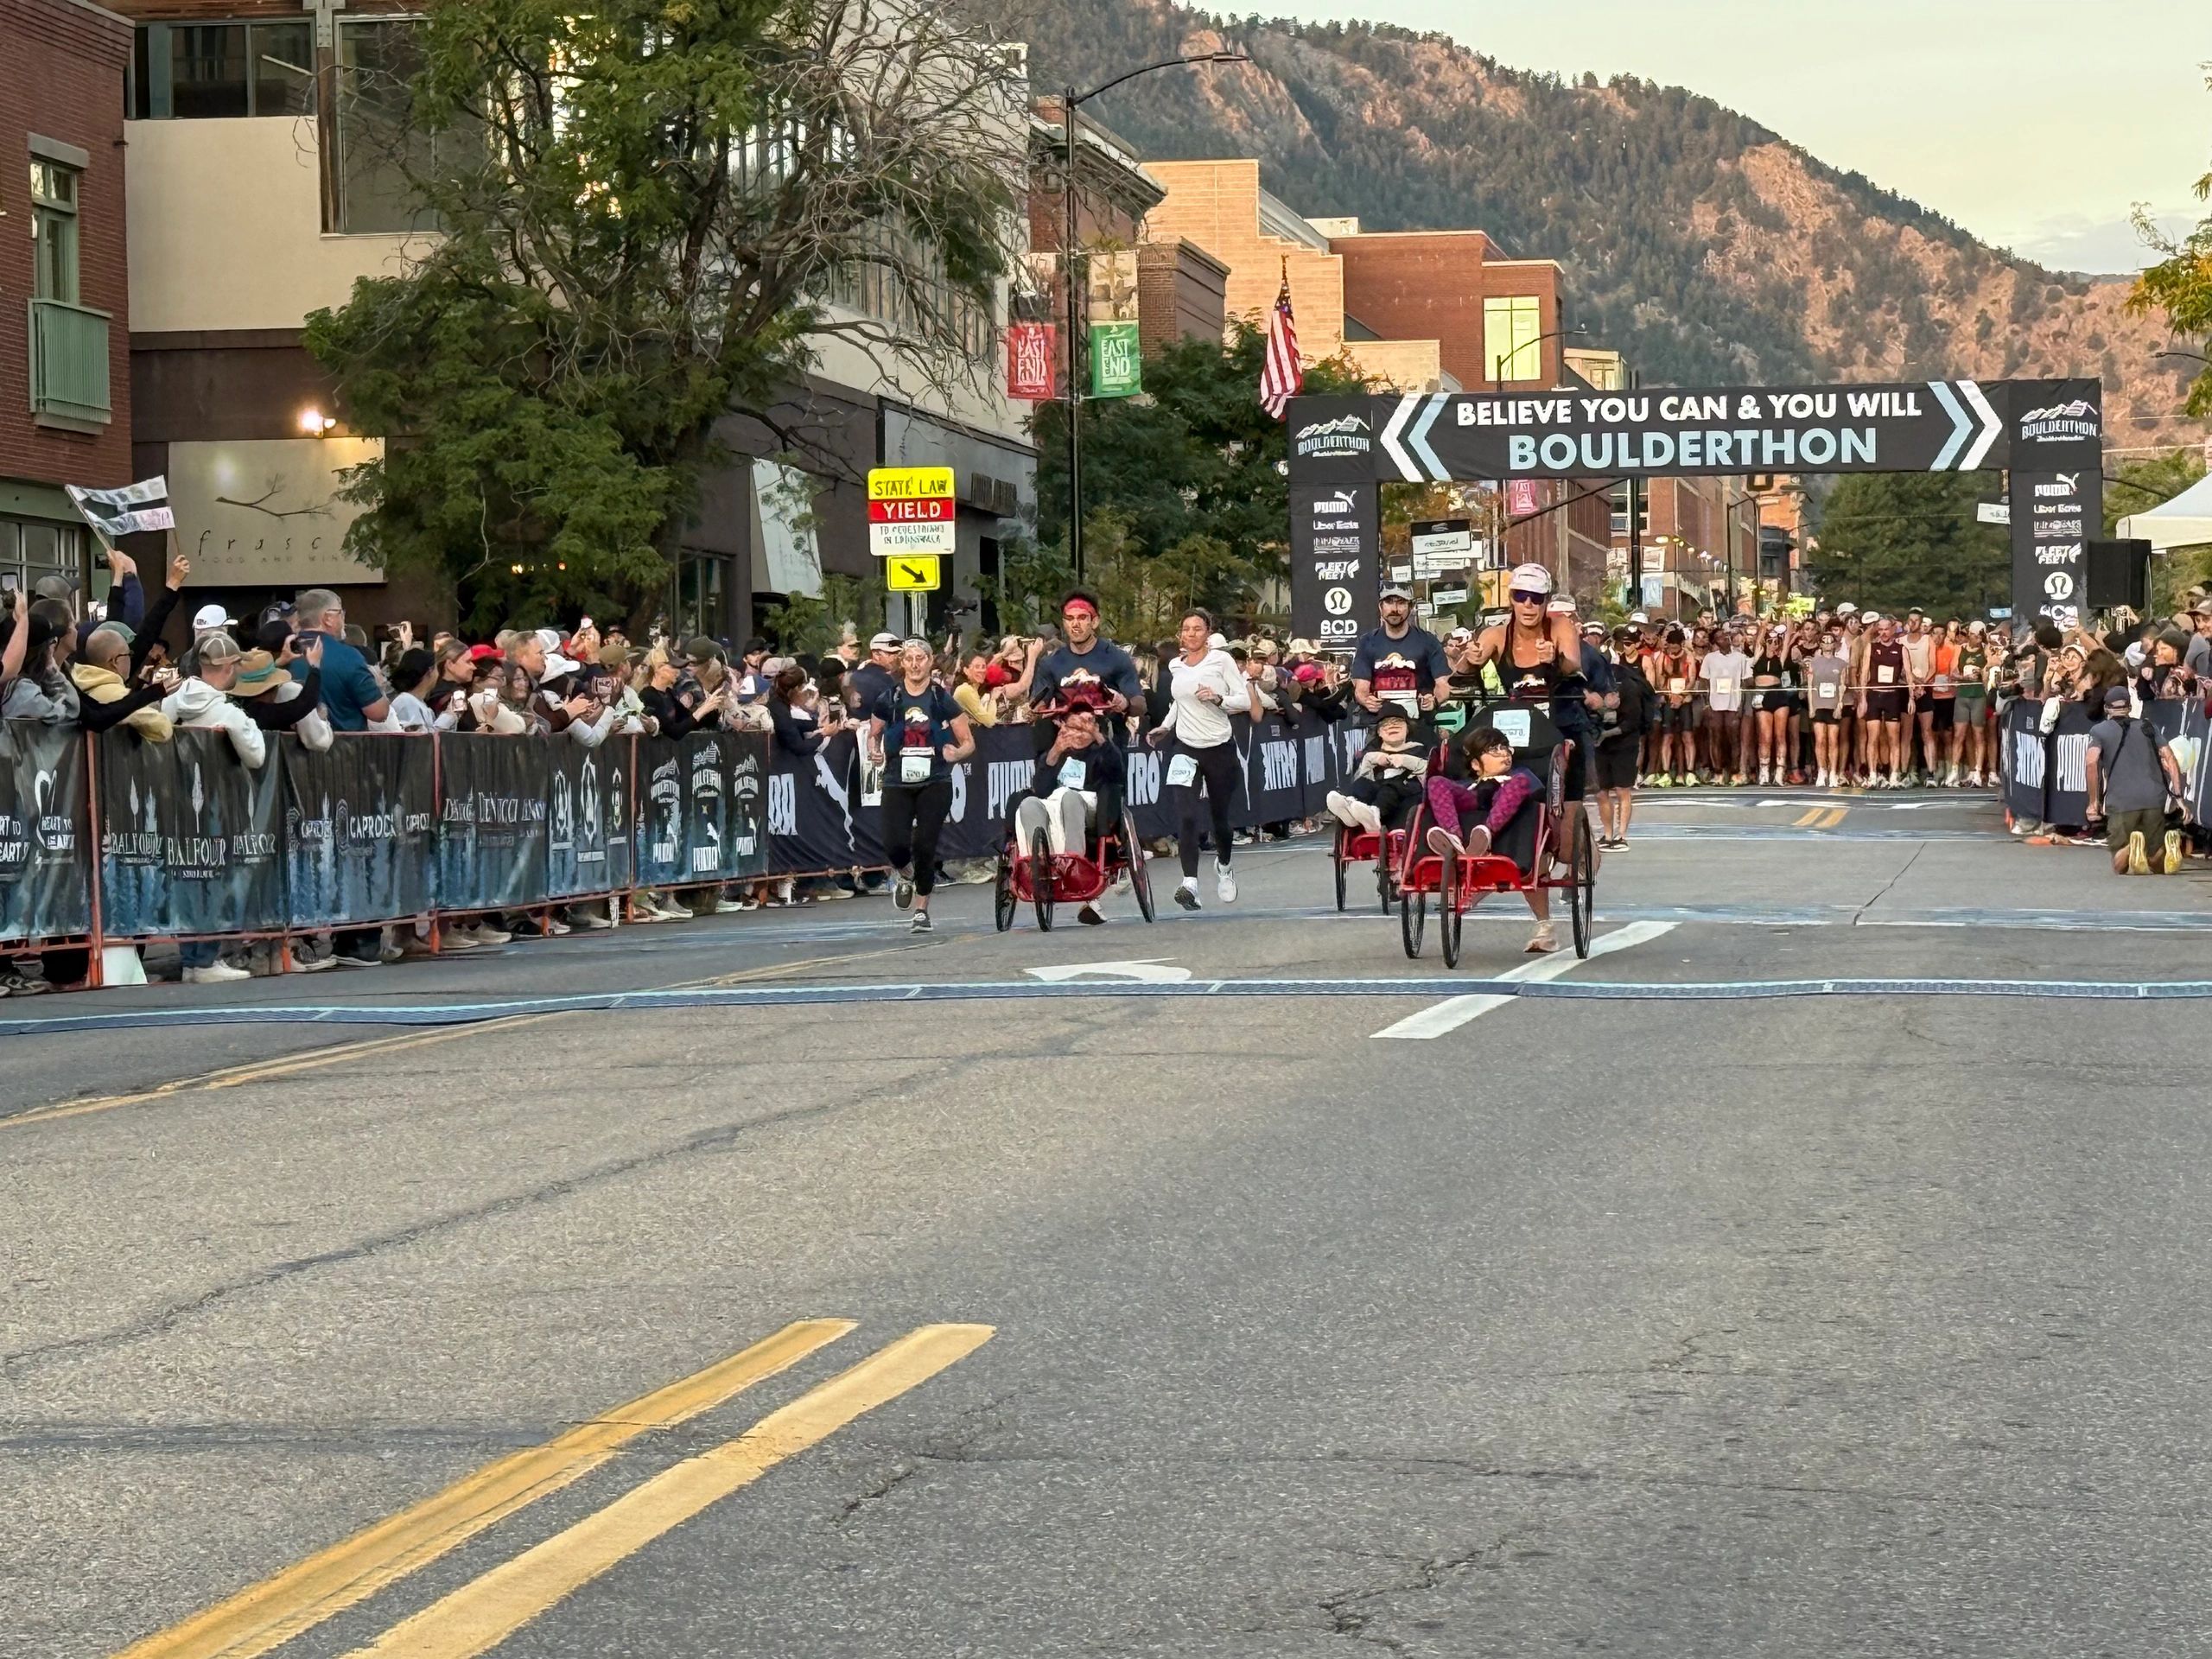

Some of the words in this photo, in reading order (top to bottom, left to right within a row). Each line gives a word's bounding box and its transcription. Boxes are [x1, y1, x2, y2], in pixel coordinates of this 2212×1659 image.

[1103, 340, 1128, 359] EAST
[1103, 358, 1131, 377] END
[1458, 400, 1572, 426] BELIEVE
[1580, 397, 1649, 423] YOU
[1659, 395, 1727, 421] CAN
[1738, 394, 1763, 420] &
[1767, 393, 1837, 418] YOU
[1847, 392, 1922, 417] WILL
[1510, 428, 1876, 470] BOULDERTHON
[874, 479, 912, 496] STATE
[919, 479, 947, 494] LAW
[883, 501, 941, 518] YIELD
[198, 530, 322, 556] frasc
[1321, 620, 1357, 635] BCD
[168, 836, 226, 867] BALFOUR
